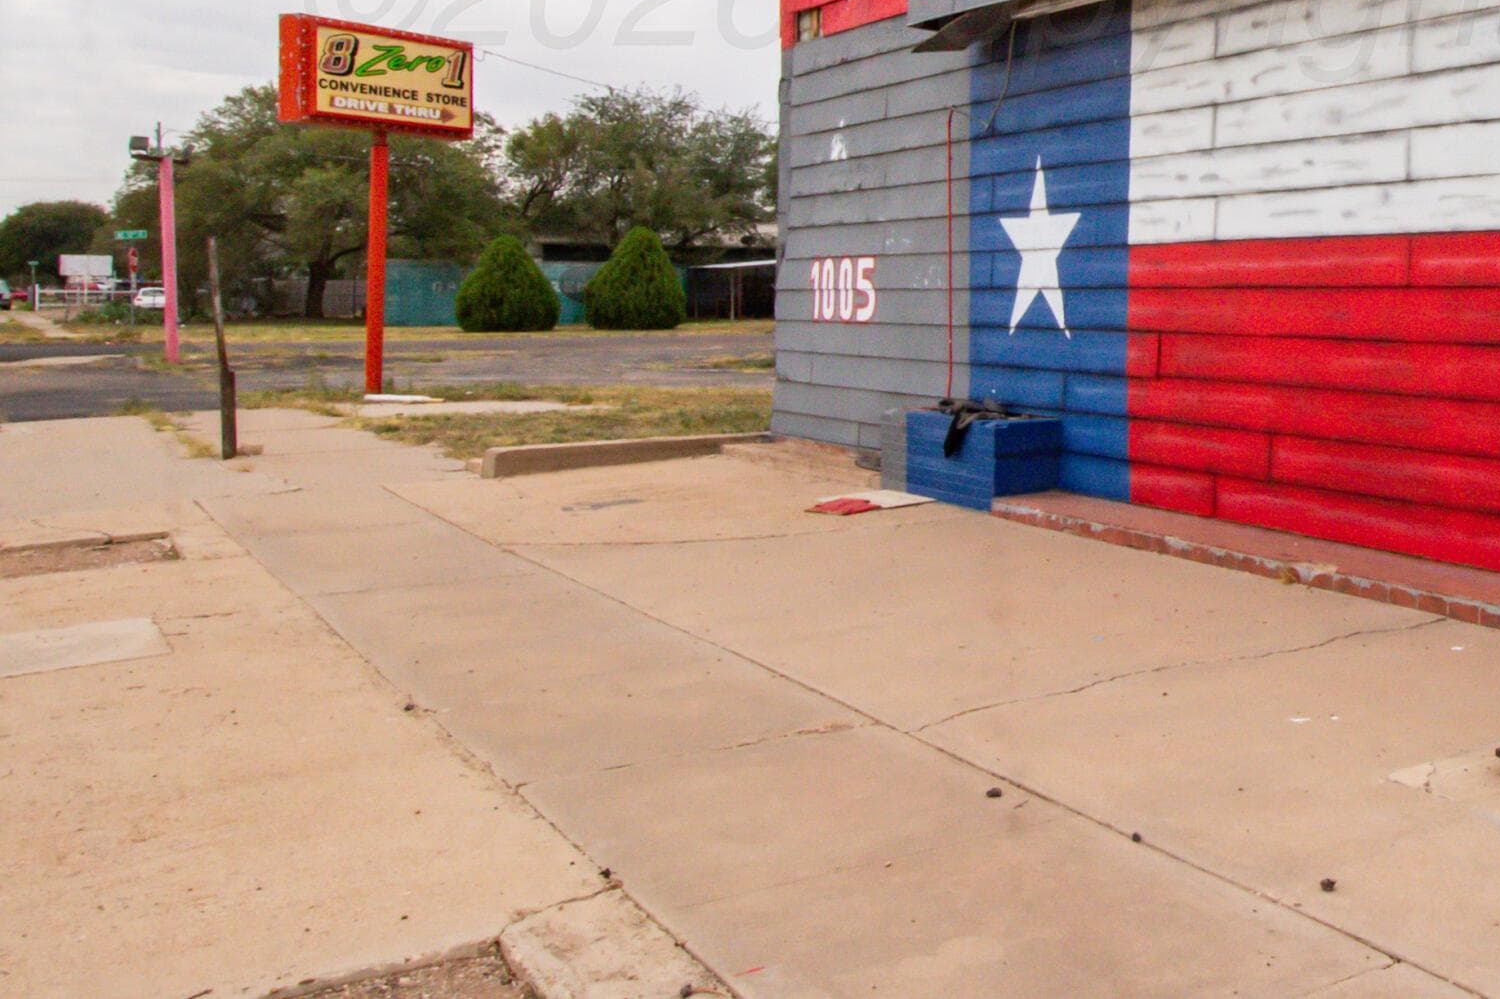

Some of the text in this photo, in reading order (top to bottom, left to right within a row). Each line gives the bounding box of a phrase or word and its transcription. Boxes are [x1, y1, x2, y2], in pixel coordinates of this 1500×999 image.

[318, 78, 468, 108] CONVENIENCE STORE
[333, 96, 441, 120] DRIVE THRU
[810, 256, 878, 324] 1005
